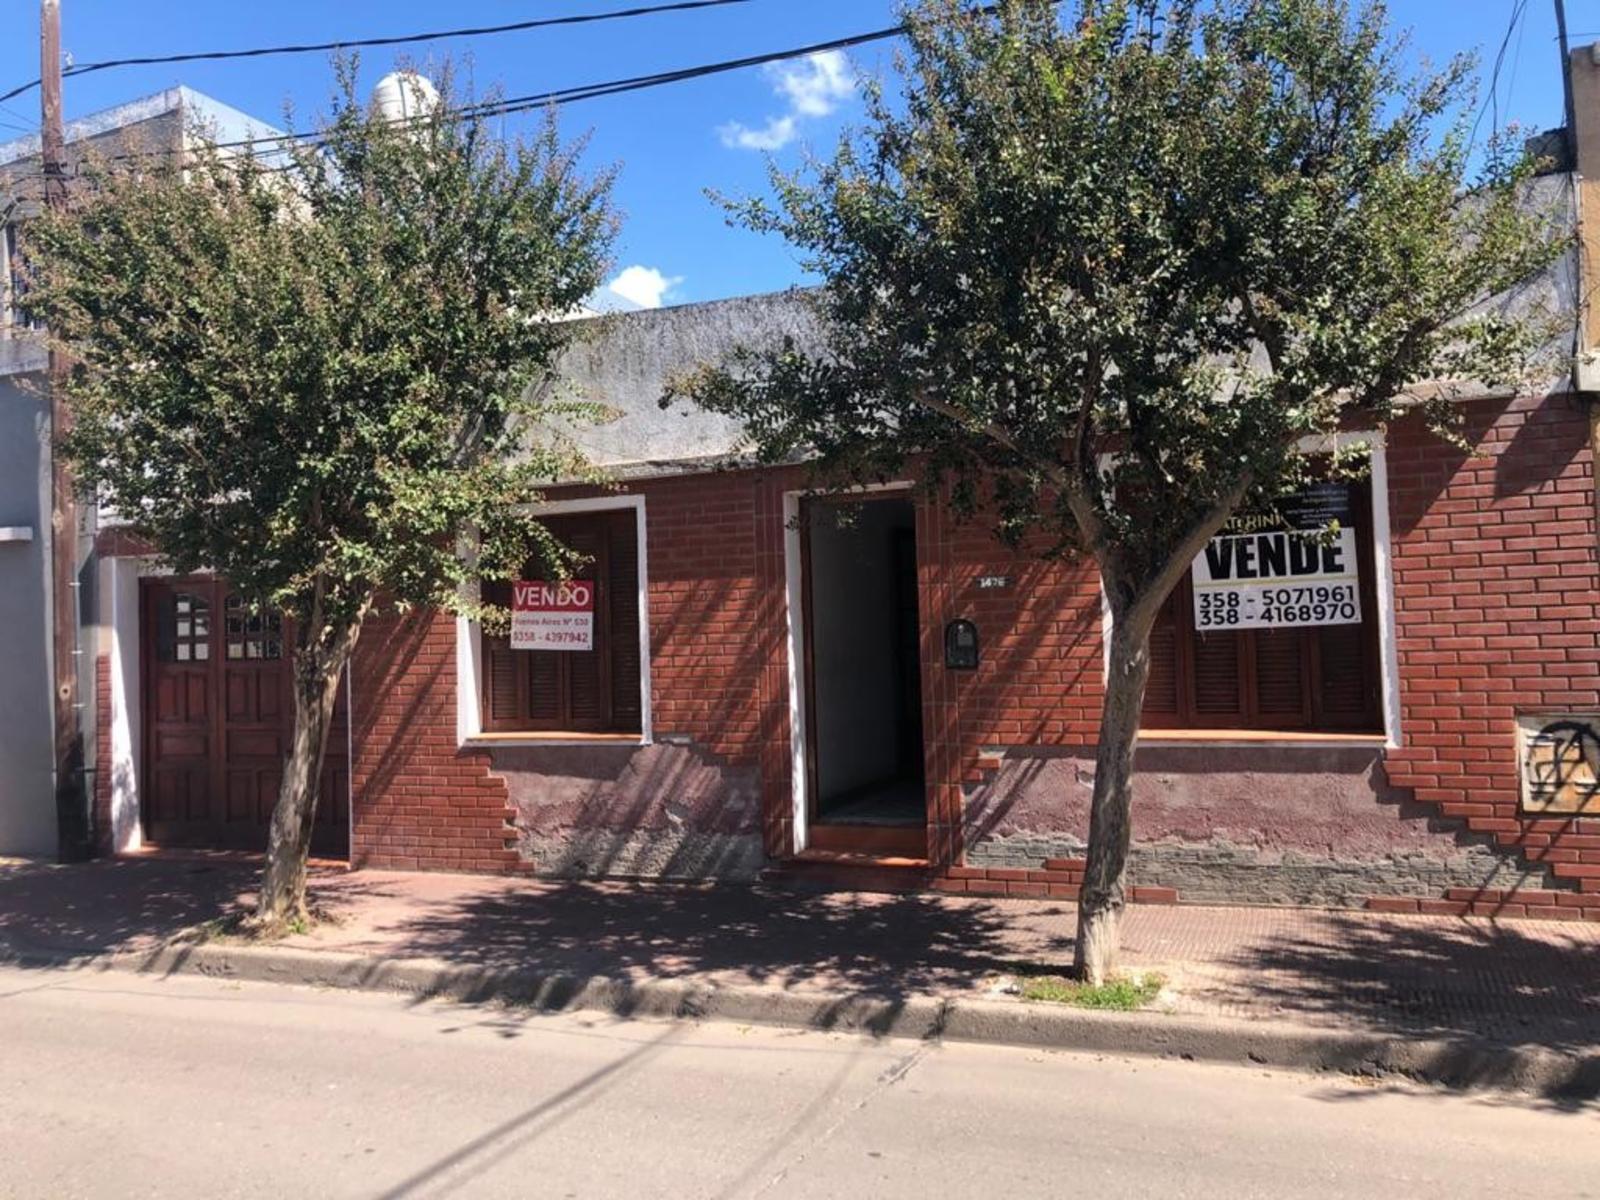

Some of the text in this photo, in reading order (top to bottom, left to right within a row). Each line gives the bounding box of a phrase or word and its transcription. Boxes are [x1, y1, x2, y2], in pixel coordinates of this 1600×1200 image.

[1205, 531, 1345, 580] VENDE
[514, 586, 590, 606] VENDO
[1199, 591, 1239, 609] 358
[1262, 585, 1354, 606] 5071961
[1199, 608, 1239, 626] 358
[1260, 602, 1356, 623] 4168970
[544, 632, 589, 642] 4397942
